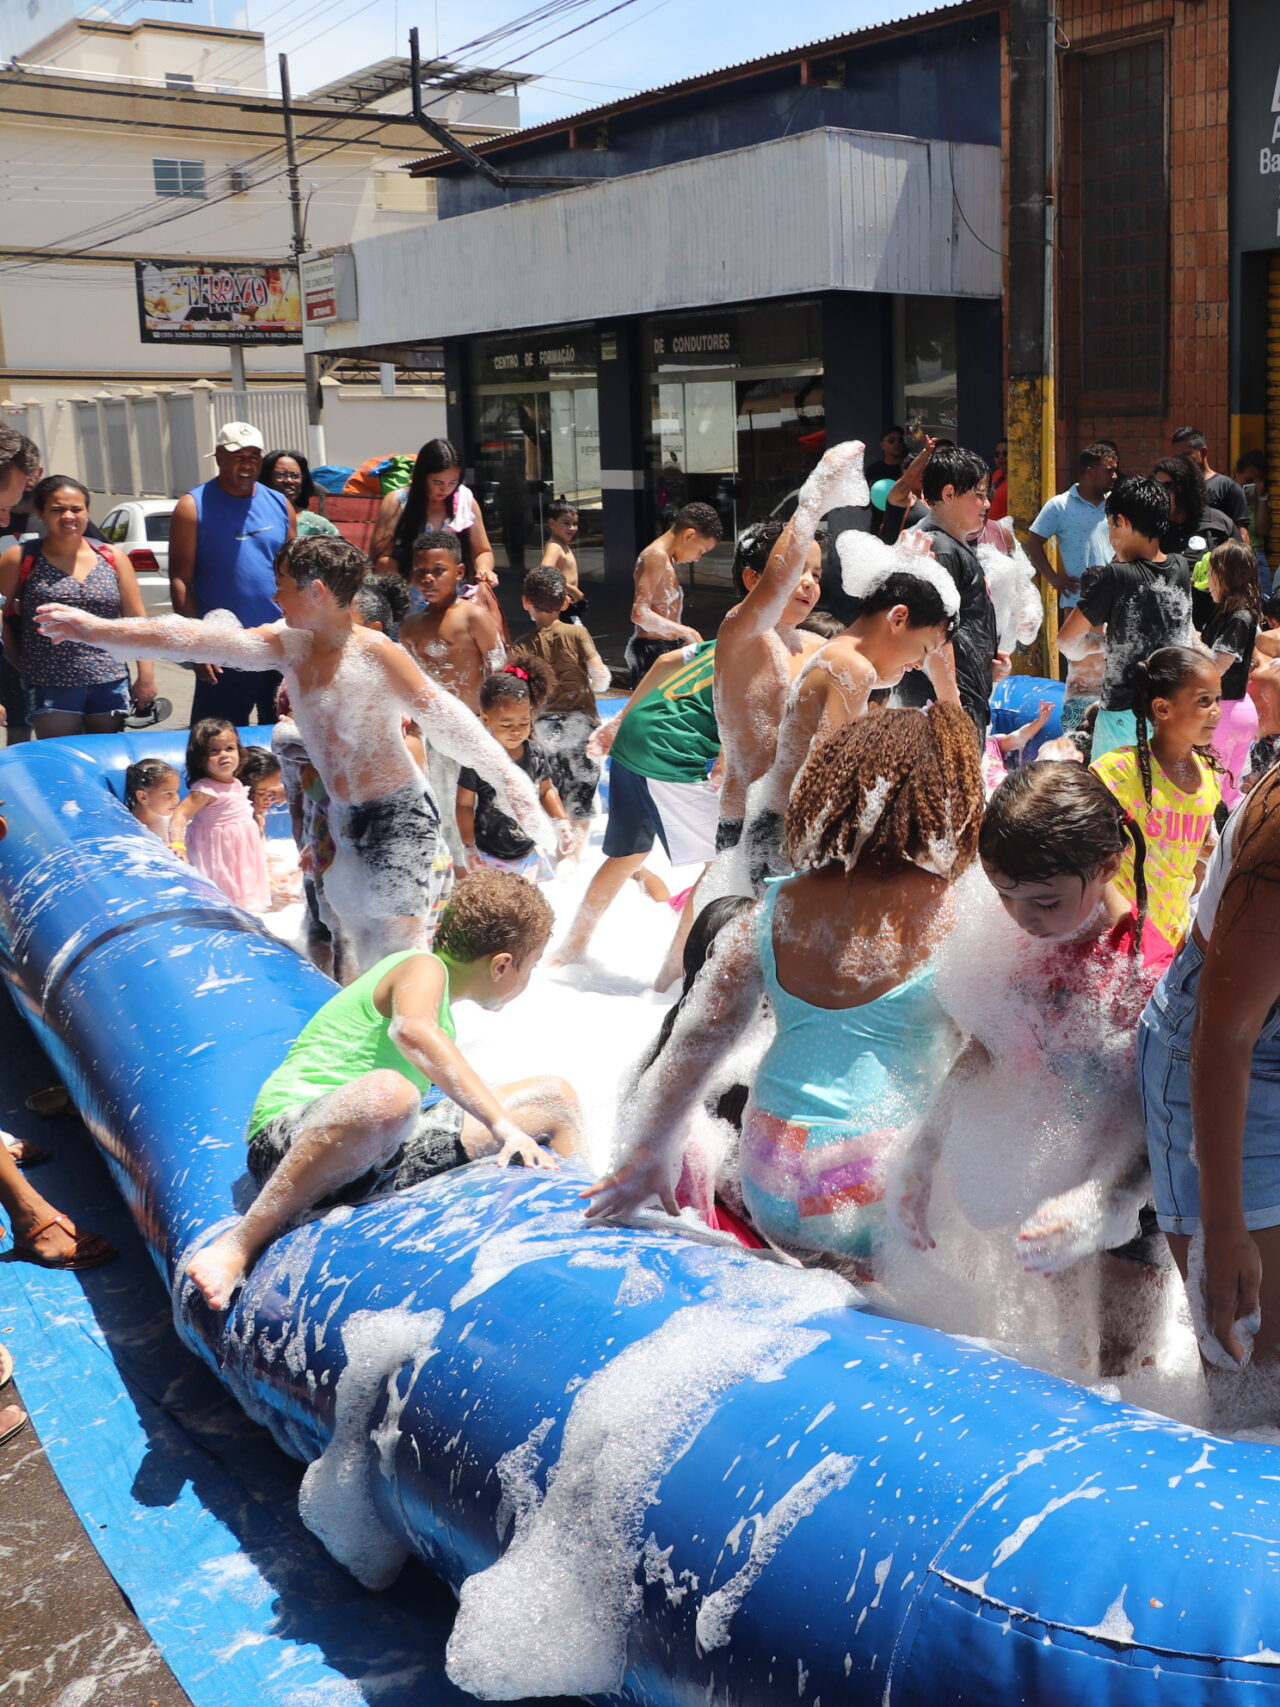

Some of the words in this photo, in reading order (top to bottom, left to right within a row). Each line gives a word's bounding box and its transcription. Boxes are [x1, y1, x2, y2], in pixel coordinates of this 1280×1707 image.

[208, 302, 243, 314] Hotel
[653, 338, 665, 354] DE
[672, 333, 730, 352] CONDUTORES
[494, 355, 519, 370] CENTRO
[524, 352, 534, 367] DE
[539, 345, 575, 365] FORMAÇÃO
